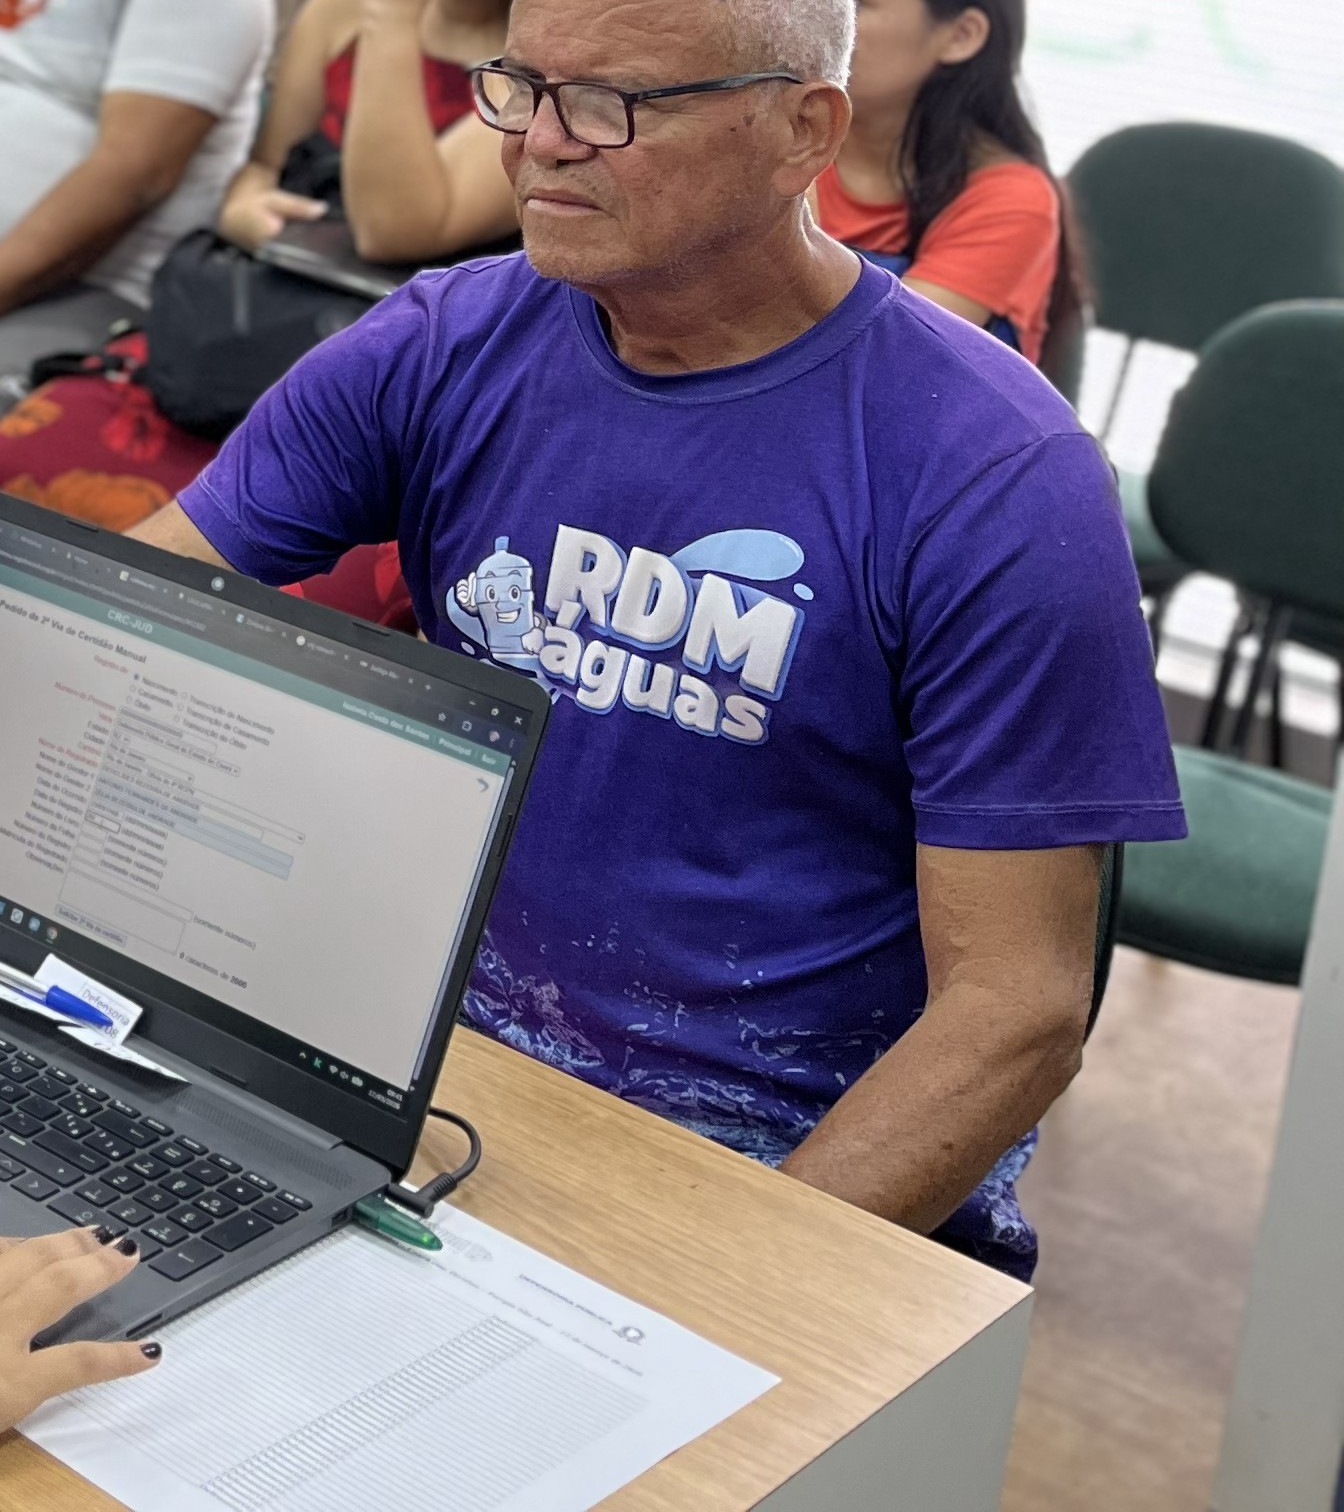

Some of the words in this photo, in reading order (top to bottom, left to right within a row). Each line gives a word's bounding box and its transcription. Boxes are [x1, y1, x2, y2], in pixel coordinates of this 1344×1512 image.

[106, 609, 153, 635] CRC-JUD
[545, 524, 797, 694] RDM
[28, 610, 40, 622] de
[50, 619, 64, 631] Via
[65, 624, 77, 636] de
[77, 629, 114, 651] Certidão
[114, 644, 147, 663] Manual
[539, 600, 769, 743] águas
[81, 989, 130, 1026] Defensoria
